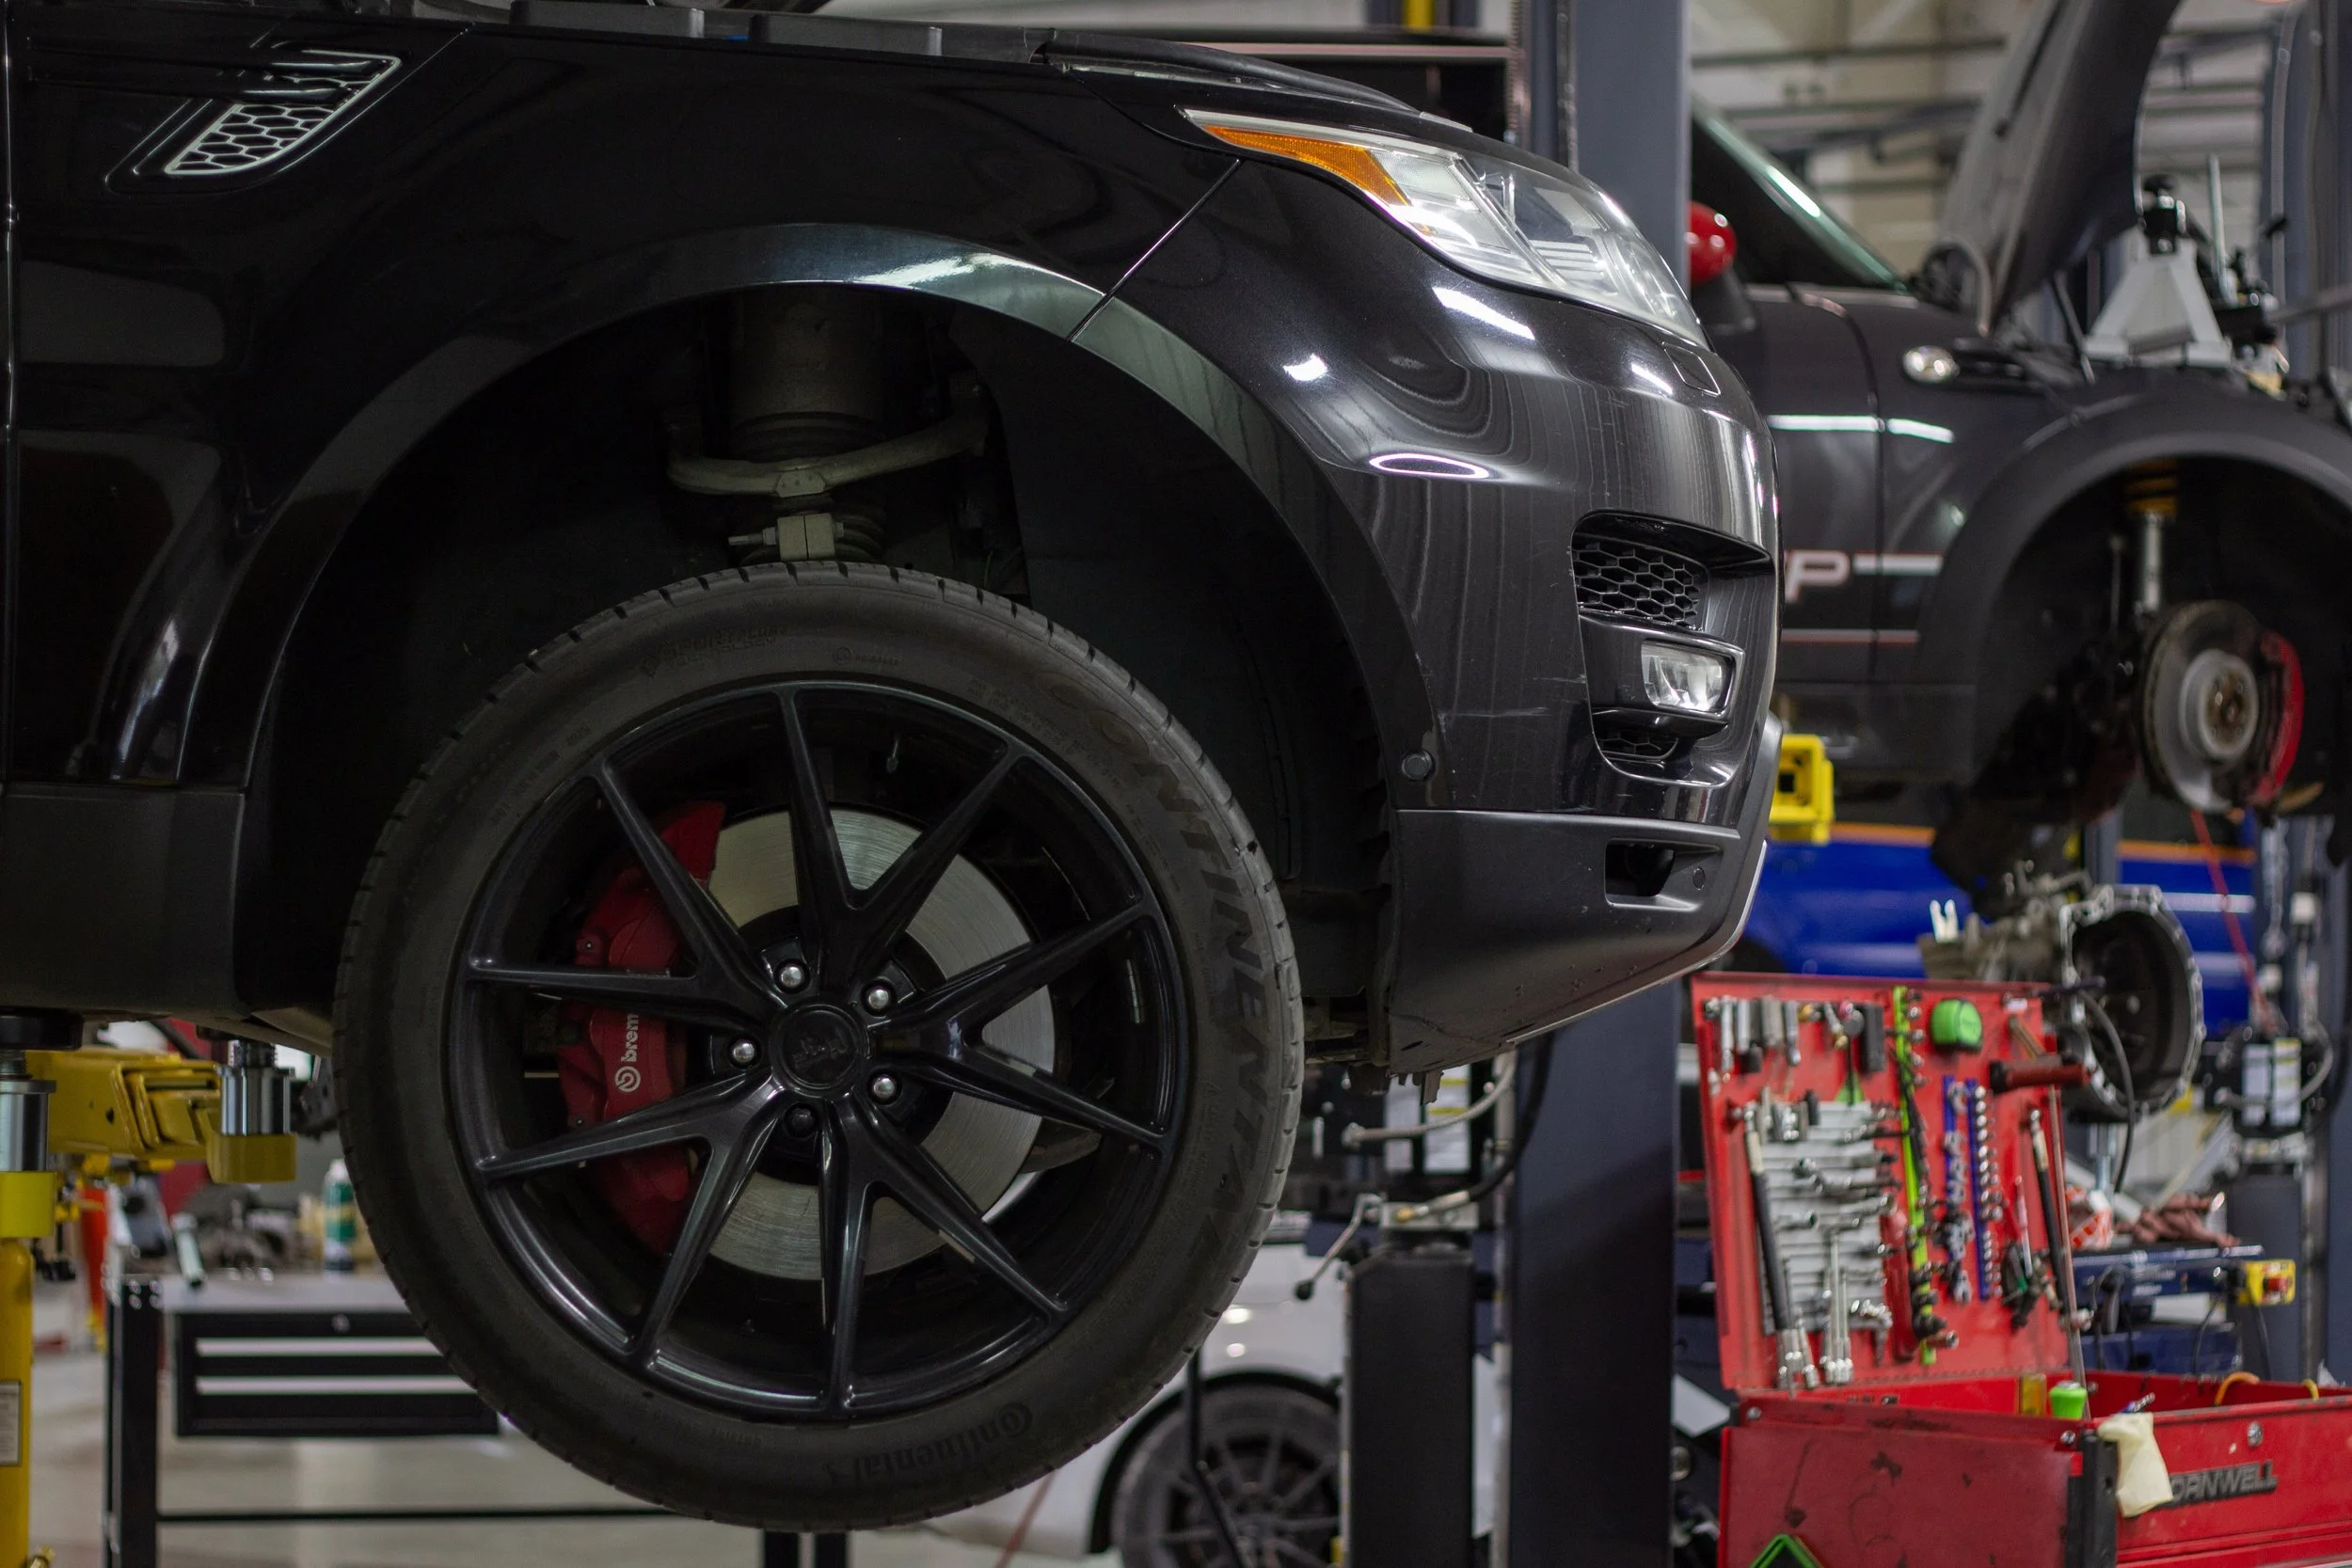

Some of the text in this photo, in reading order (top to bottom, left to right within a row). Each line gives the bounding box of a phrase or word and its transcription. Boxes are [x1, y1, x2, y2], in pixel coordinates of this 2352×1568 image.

[1785, 549, 1851, 603] P
[620, 1013, 639, 1062] brem
[2164, 1460, 2278, 1507] ORNWELL
